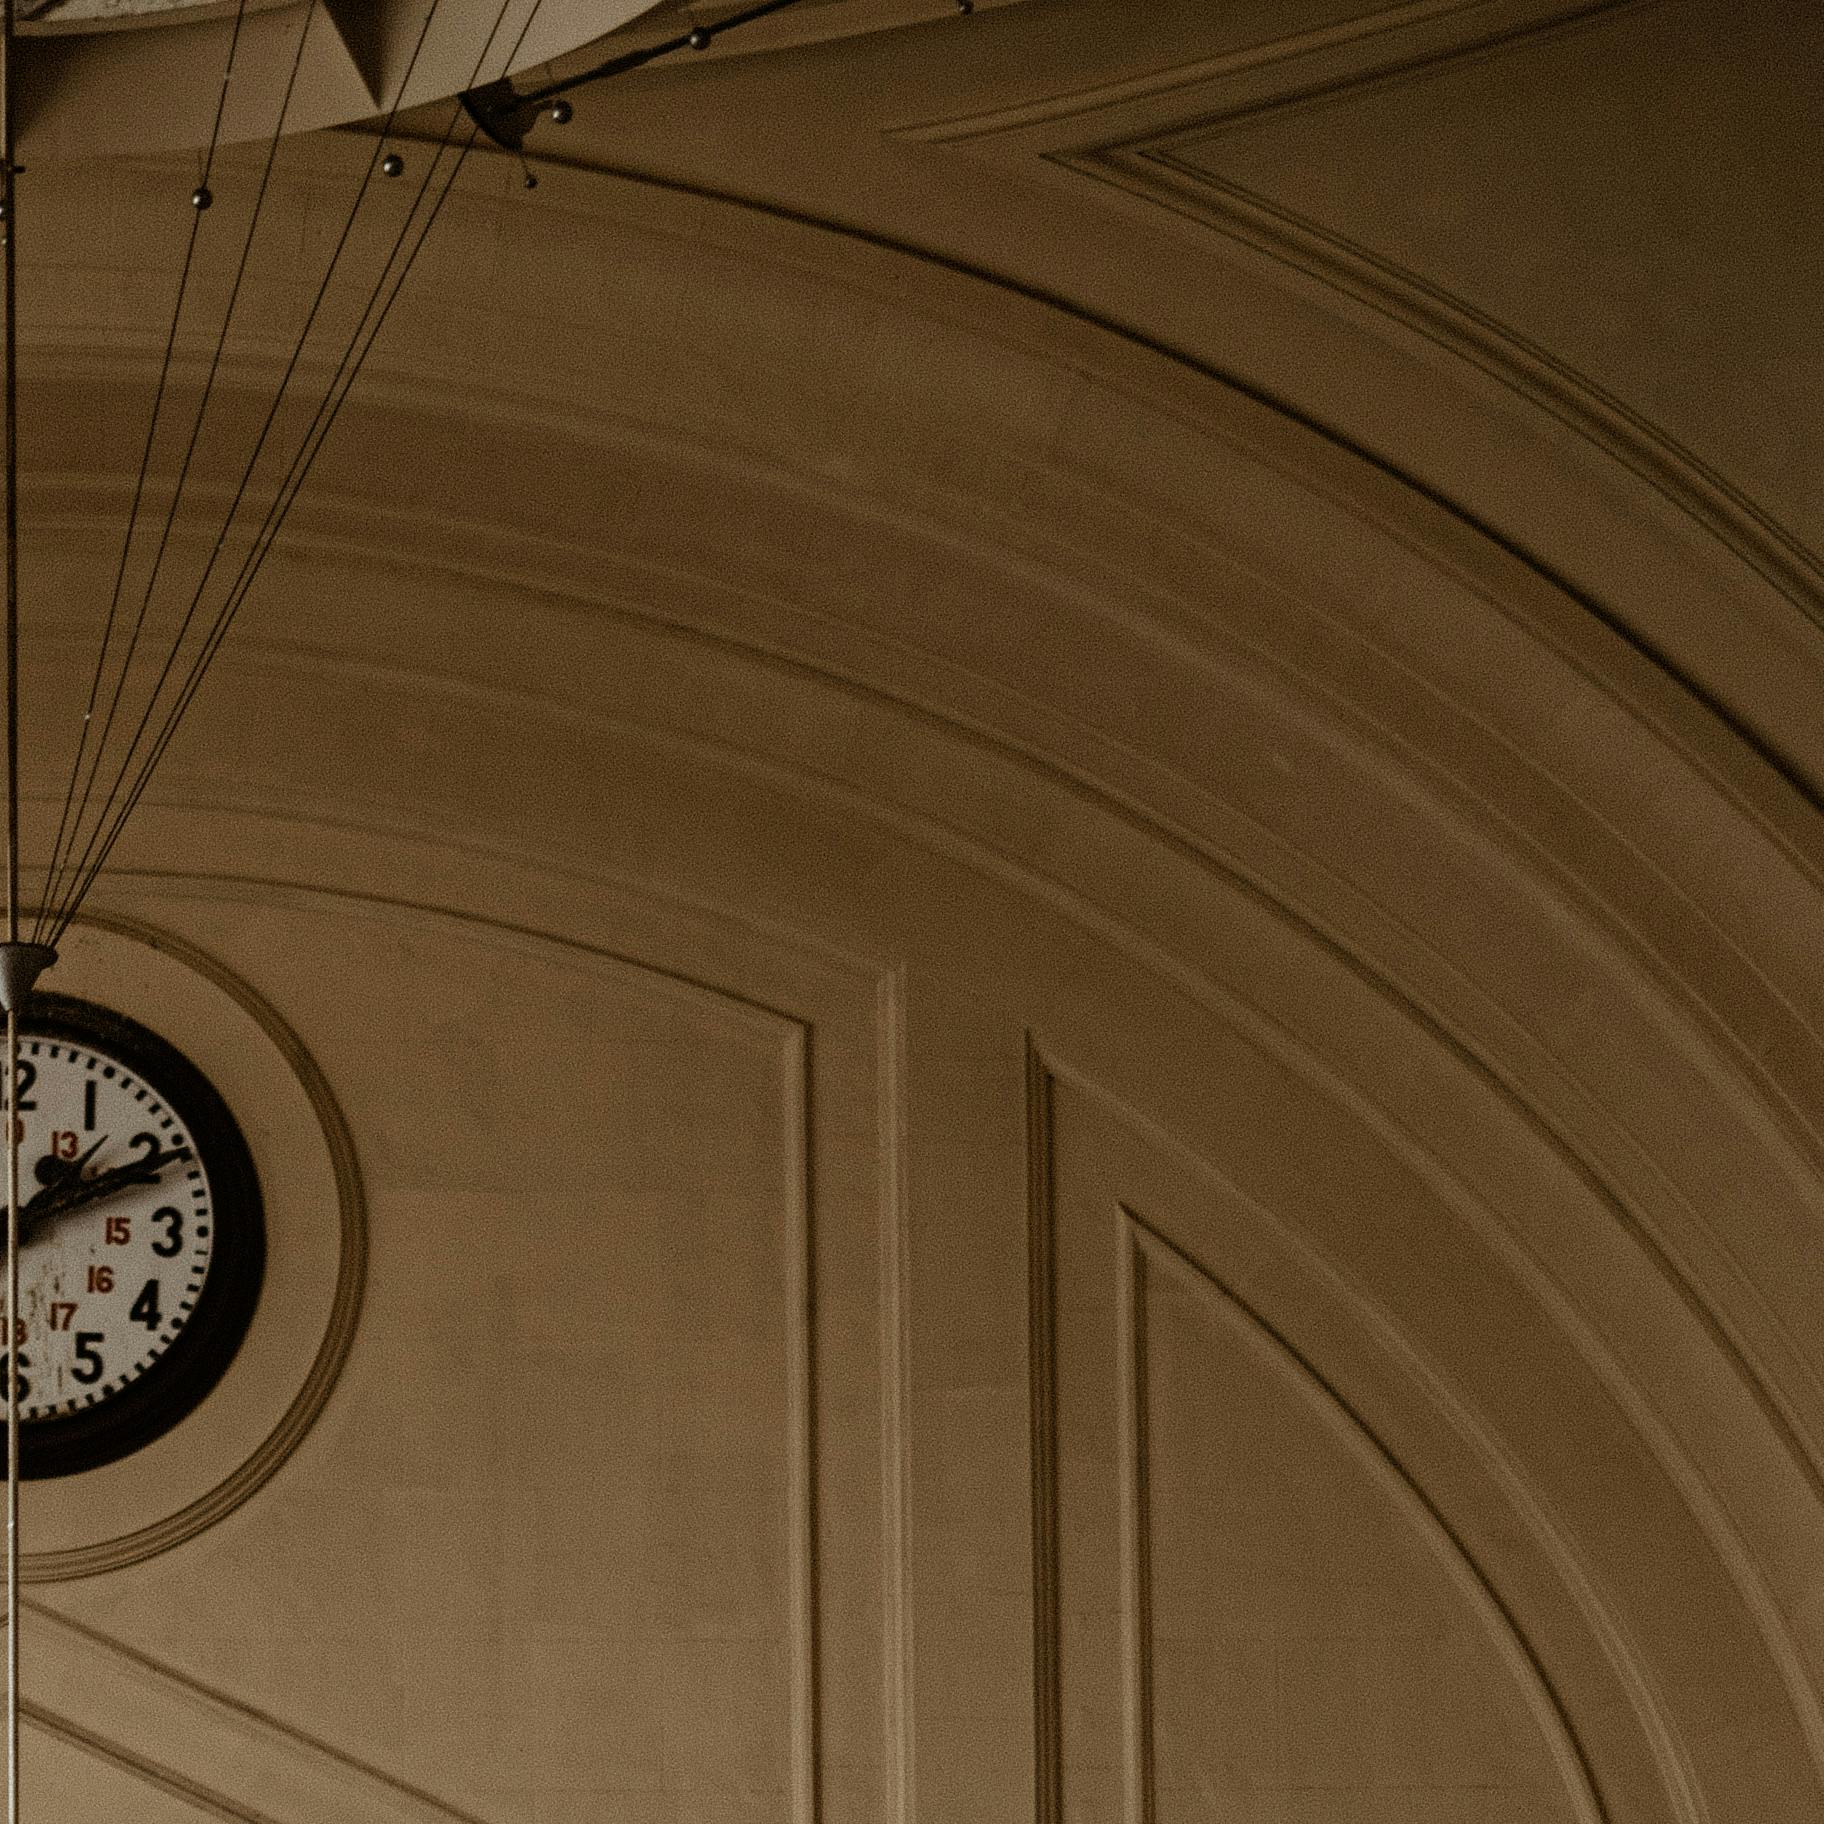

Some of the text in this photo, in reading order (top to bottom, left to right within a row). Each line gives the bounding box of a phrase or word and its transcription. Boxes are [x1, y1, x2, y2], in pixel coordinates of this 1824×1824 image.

[84, 1079, 96, 1131] 1
[51, 1131, 77, 1158] 13
[106, 1217, 130, 1246] 15
[151, 1207, 184, 1259] 3
[87, 1265, 115, 1293] 16
[50, 1302, 77, 1331] 17
[130, 1279, 163, 1331] 4
[0, 1316, 27, 1346] 18
[72, 1332, 104, 1384] 5
